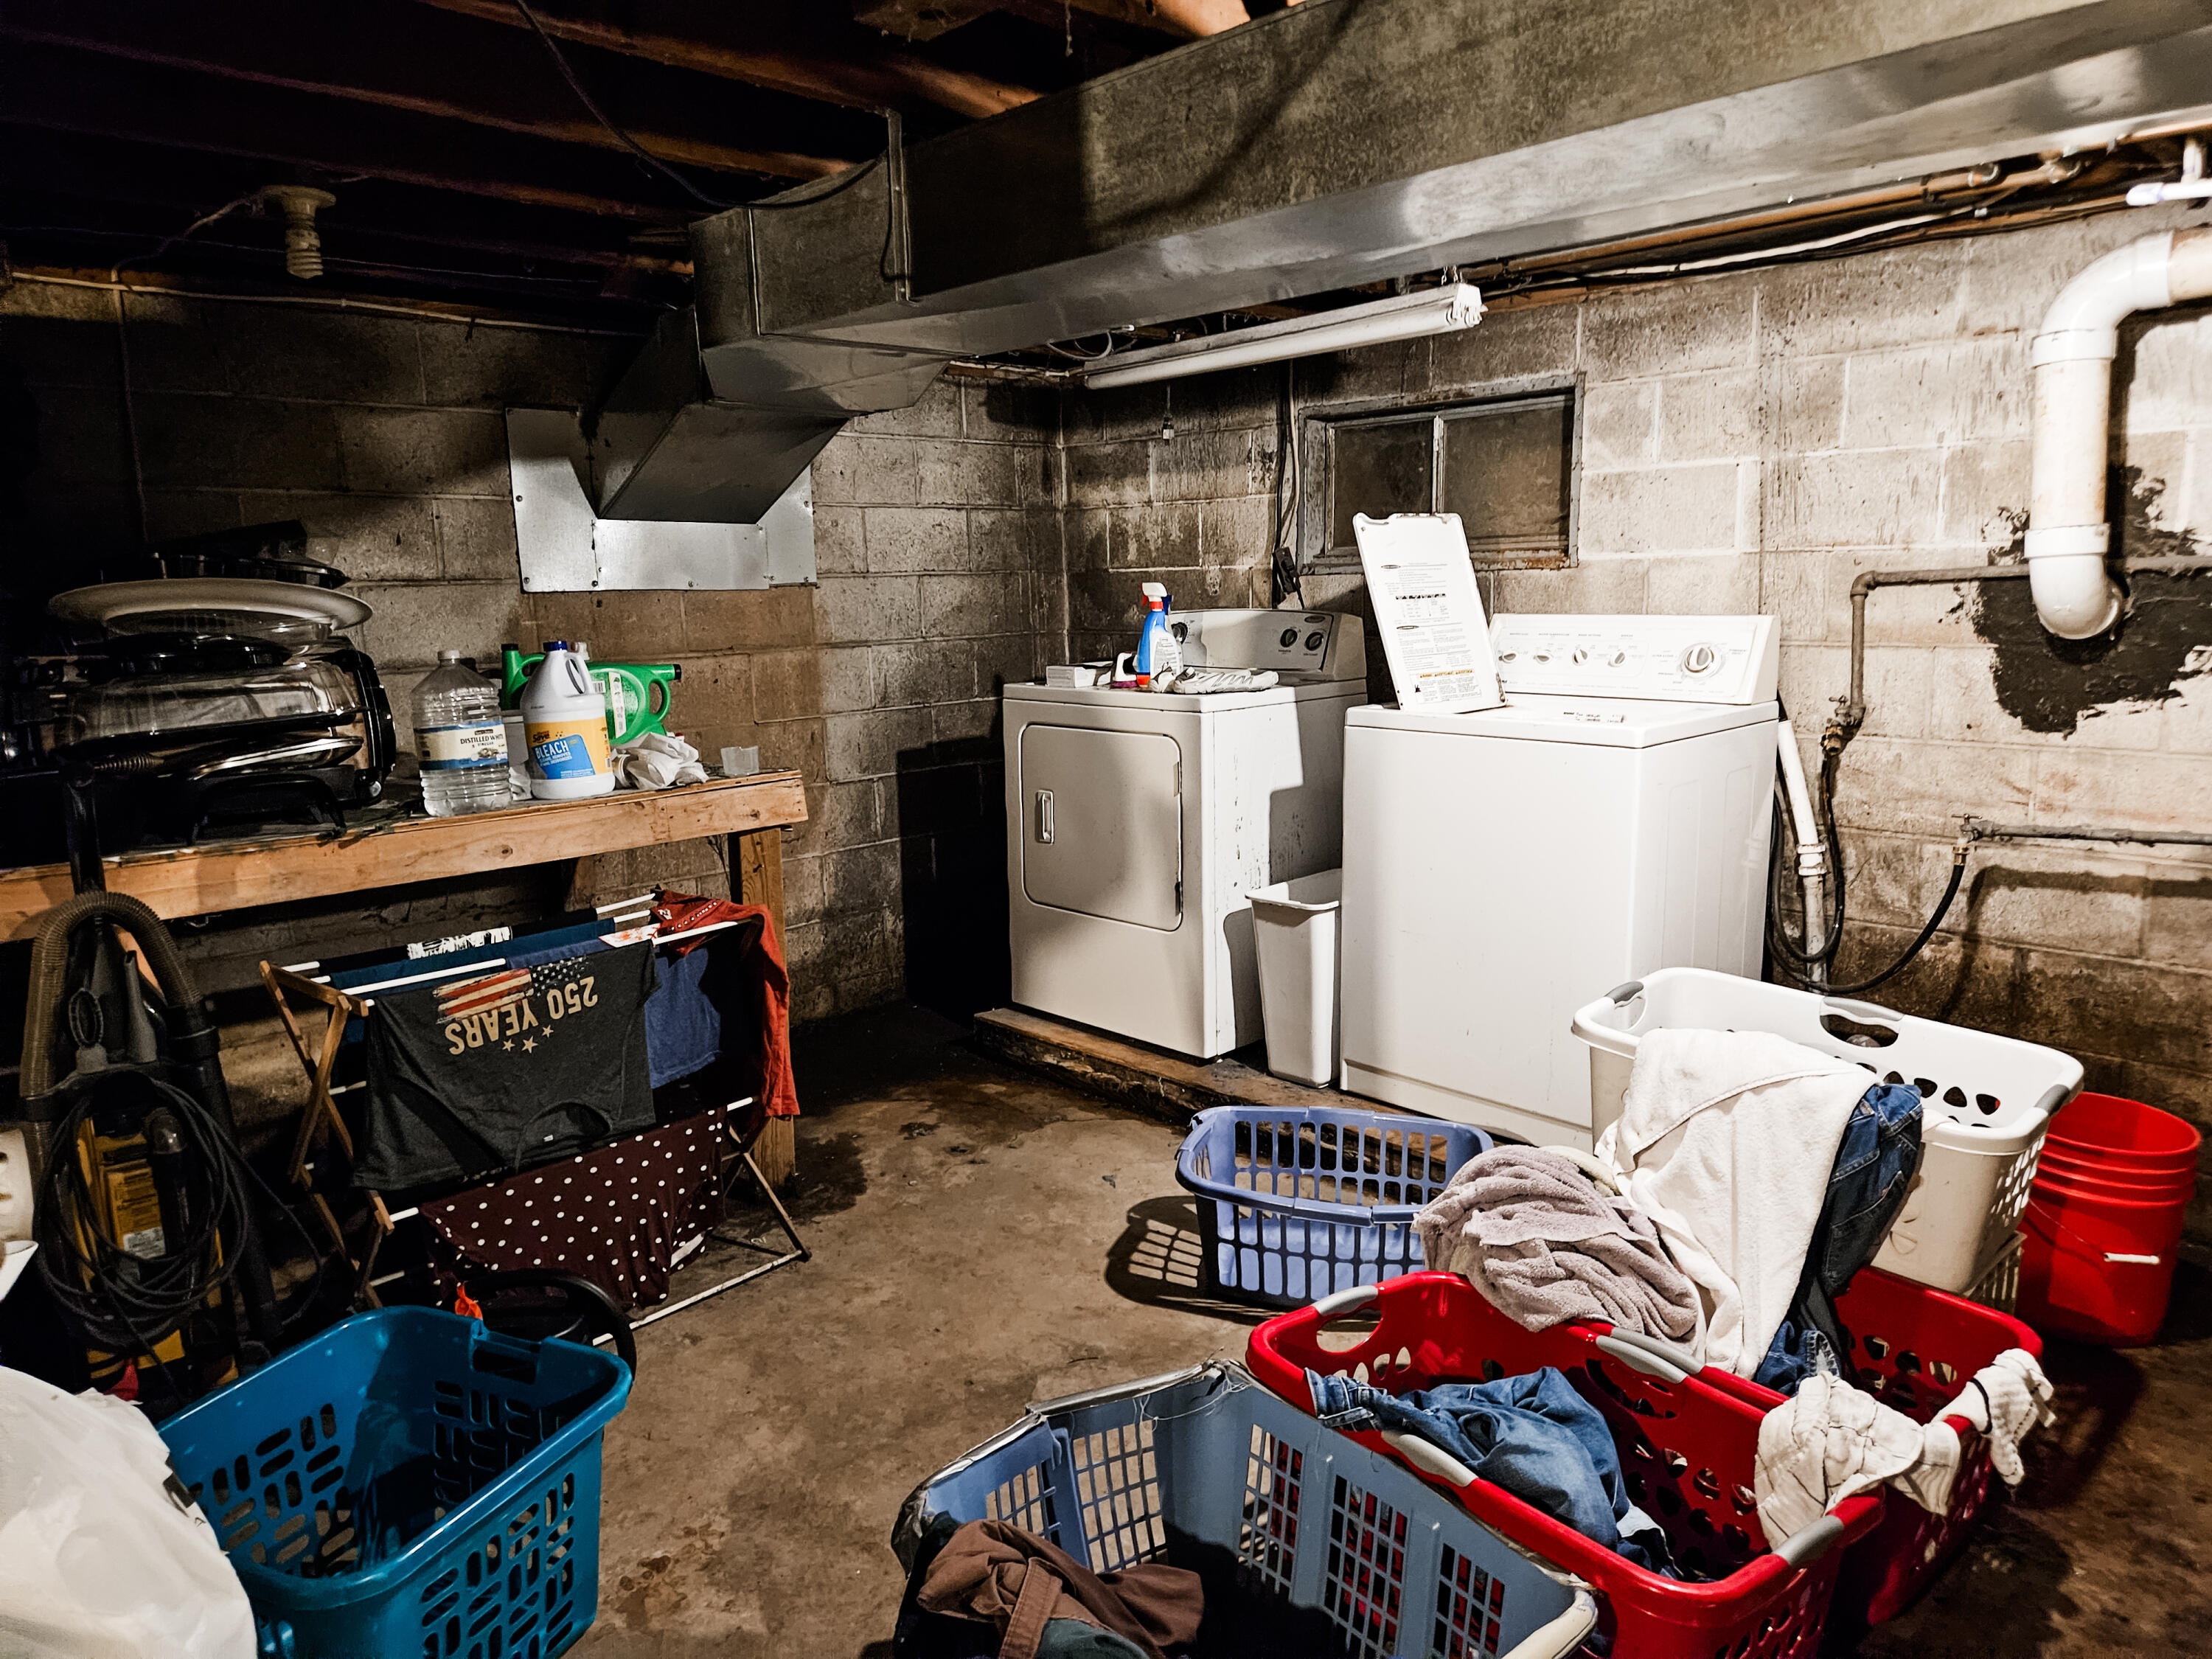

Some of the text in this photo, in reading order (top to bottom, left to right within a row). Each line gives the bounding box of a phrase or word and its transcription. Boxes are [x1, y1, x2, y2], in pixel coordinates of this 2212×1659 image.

[460, 736, 490, 745] DISTILLED
[535, 740, 569, 759] BLEACH
[445, 975, 598, 1055] 250 YEARS
